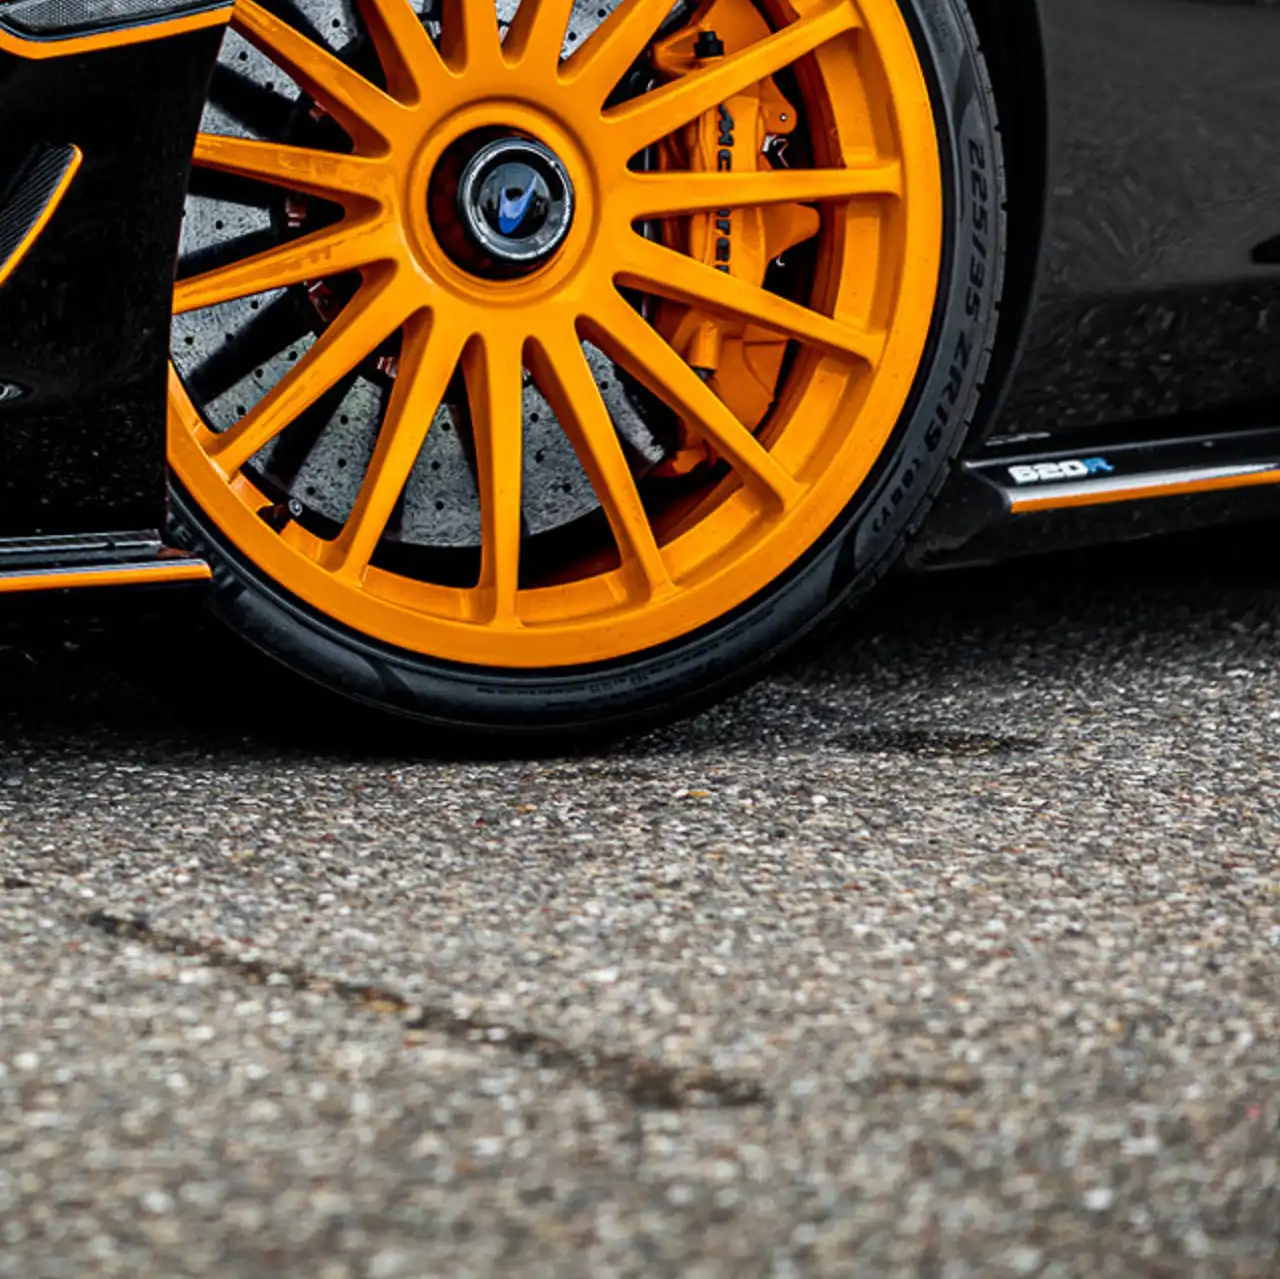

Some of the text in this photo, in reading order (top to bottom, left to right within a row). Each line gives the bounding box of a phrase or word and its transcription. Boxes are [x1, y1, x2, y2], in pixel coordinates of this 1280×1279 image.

[964, 136, 987, 323] 225/35
[922, 331, 973, 454] ZR19
[1008, 456, 1115, 484] 620R
